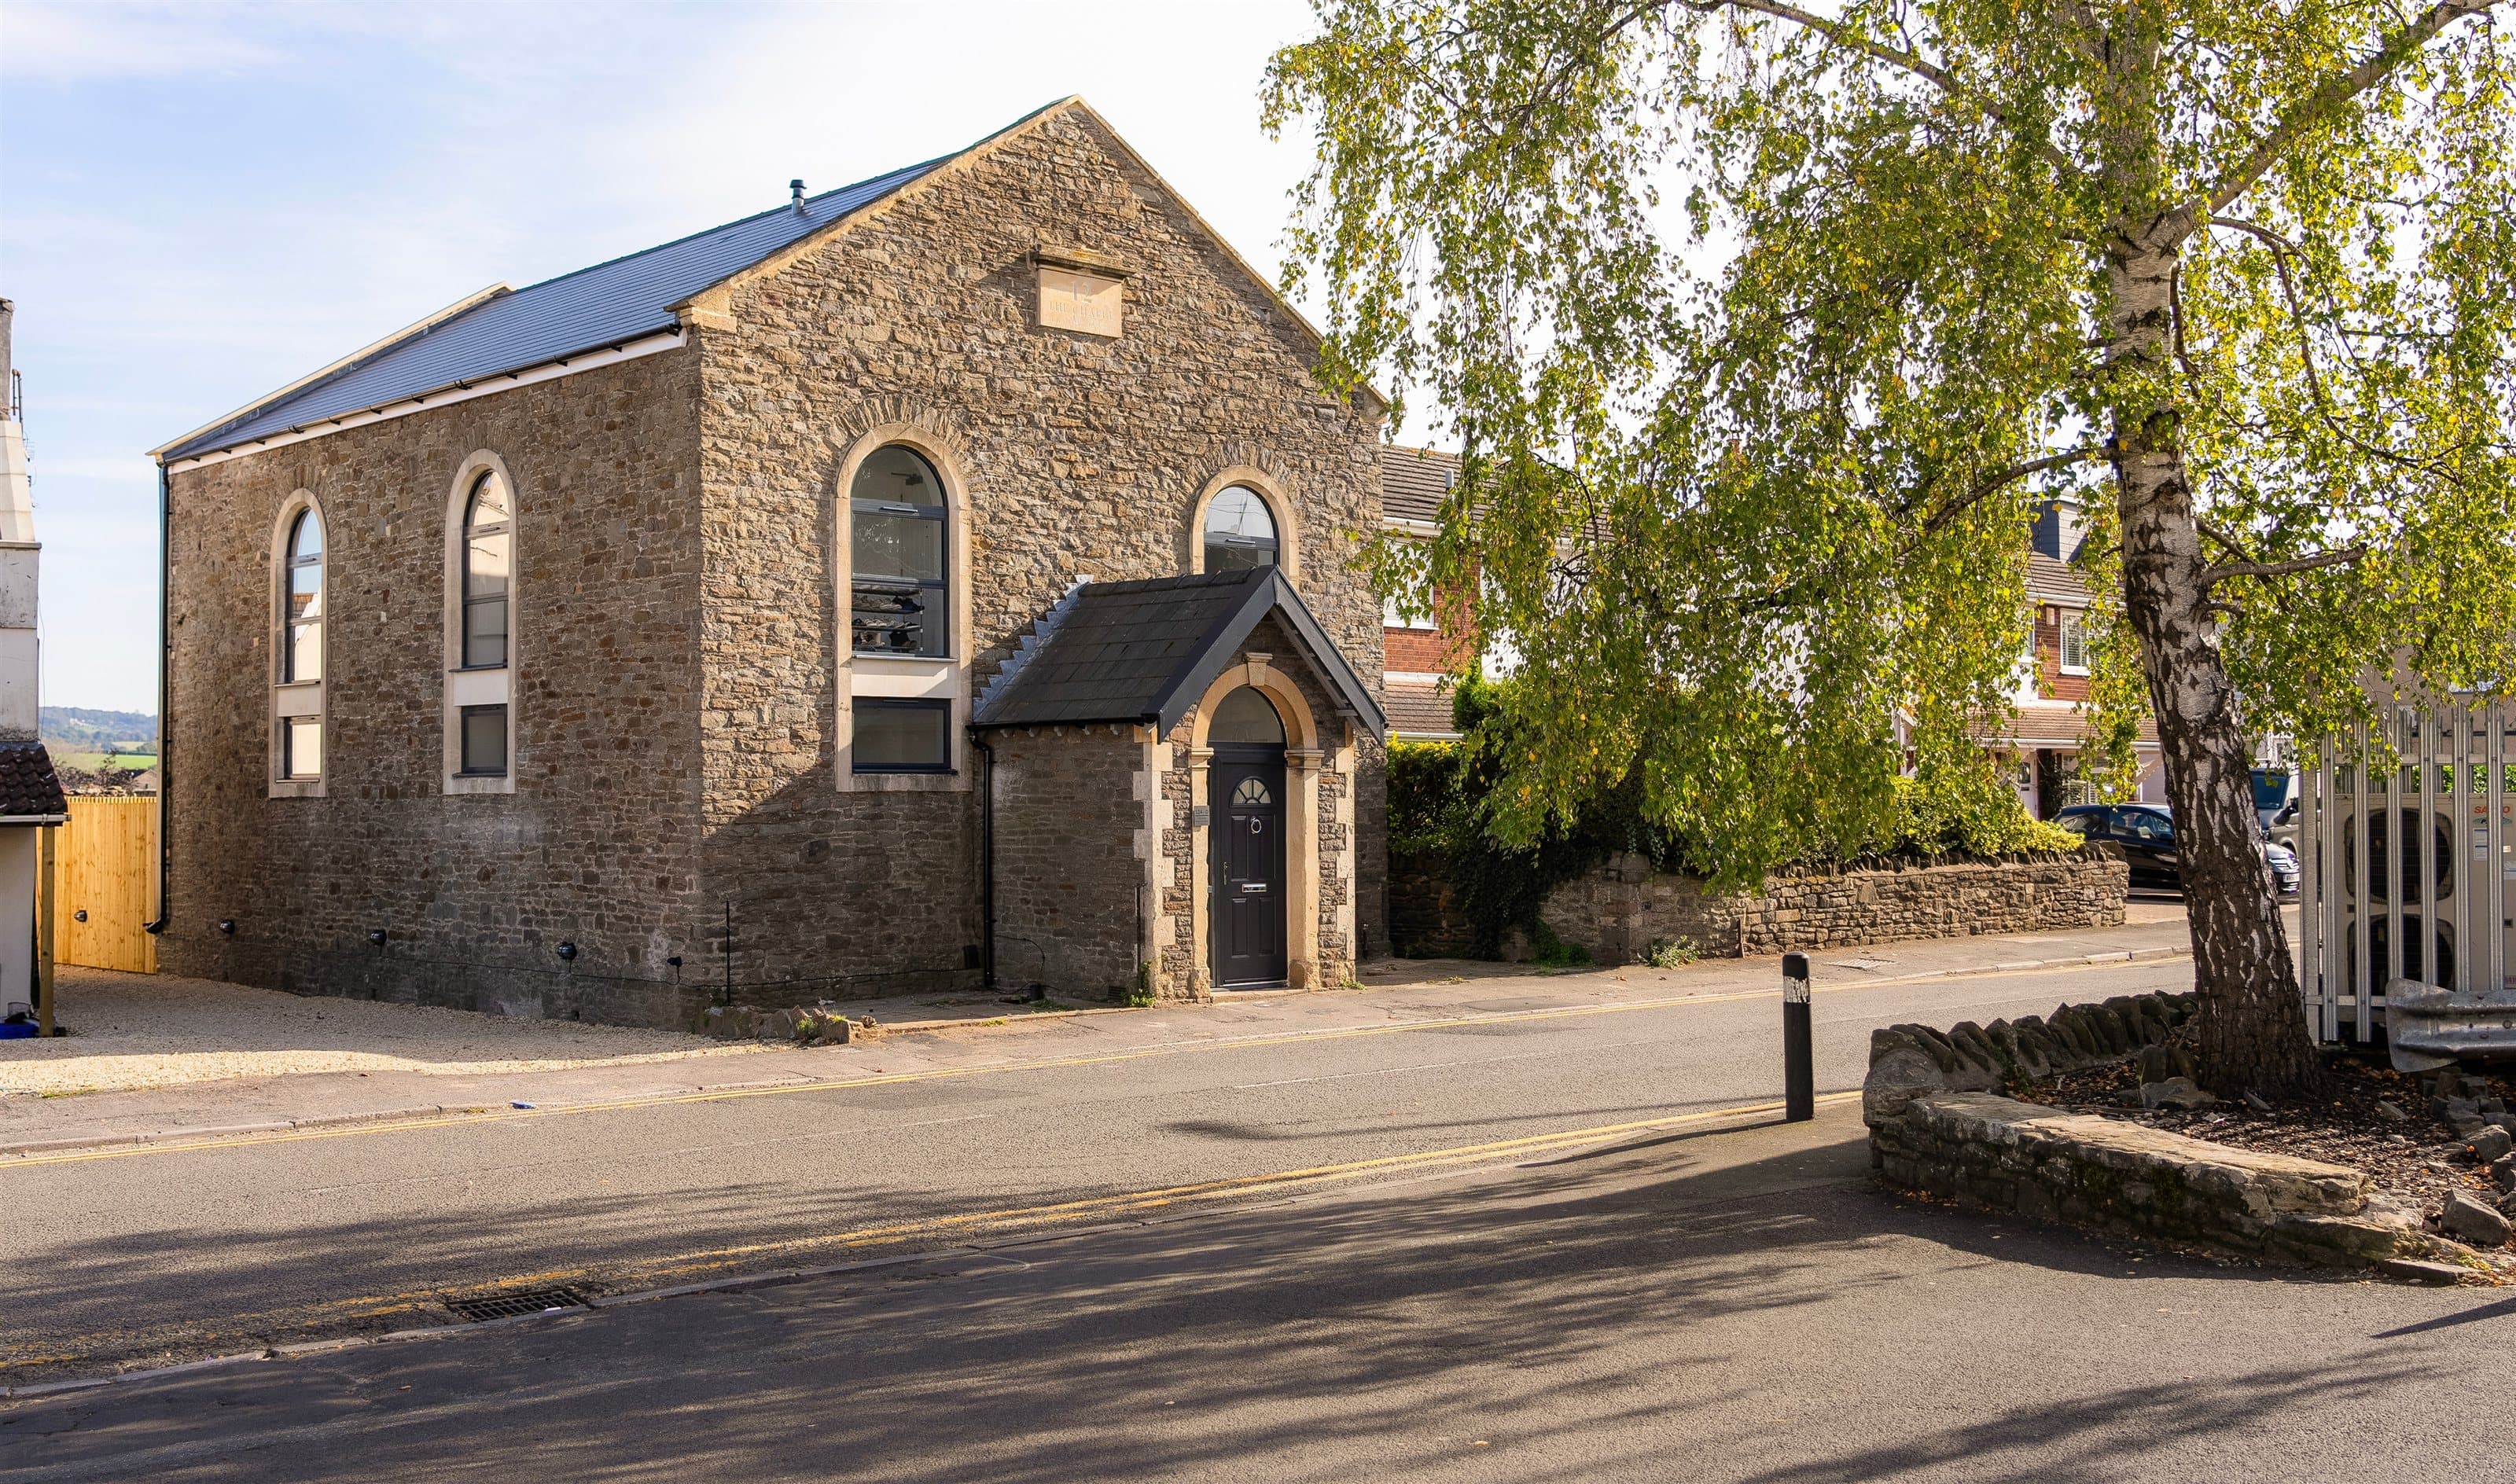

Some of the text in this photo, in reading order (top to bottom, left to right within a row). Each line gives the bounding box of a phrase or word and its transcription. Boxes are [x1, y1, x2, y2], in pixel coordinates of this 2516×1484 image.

[1071, 281, 1092, 303] 12
[1049, 301, 1113, 321] THE CHAPEL
